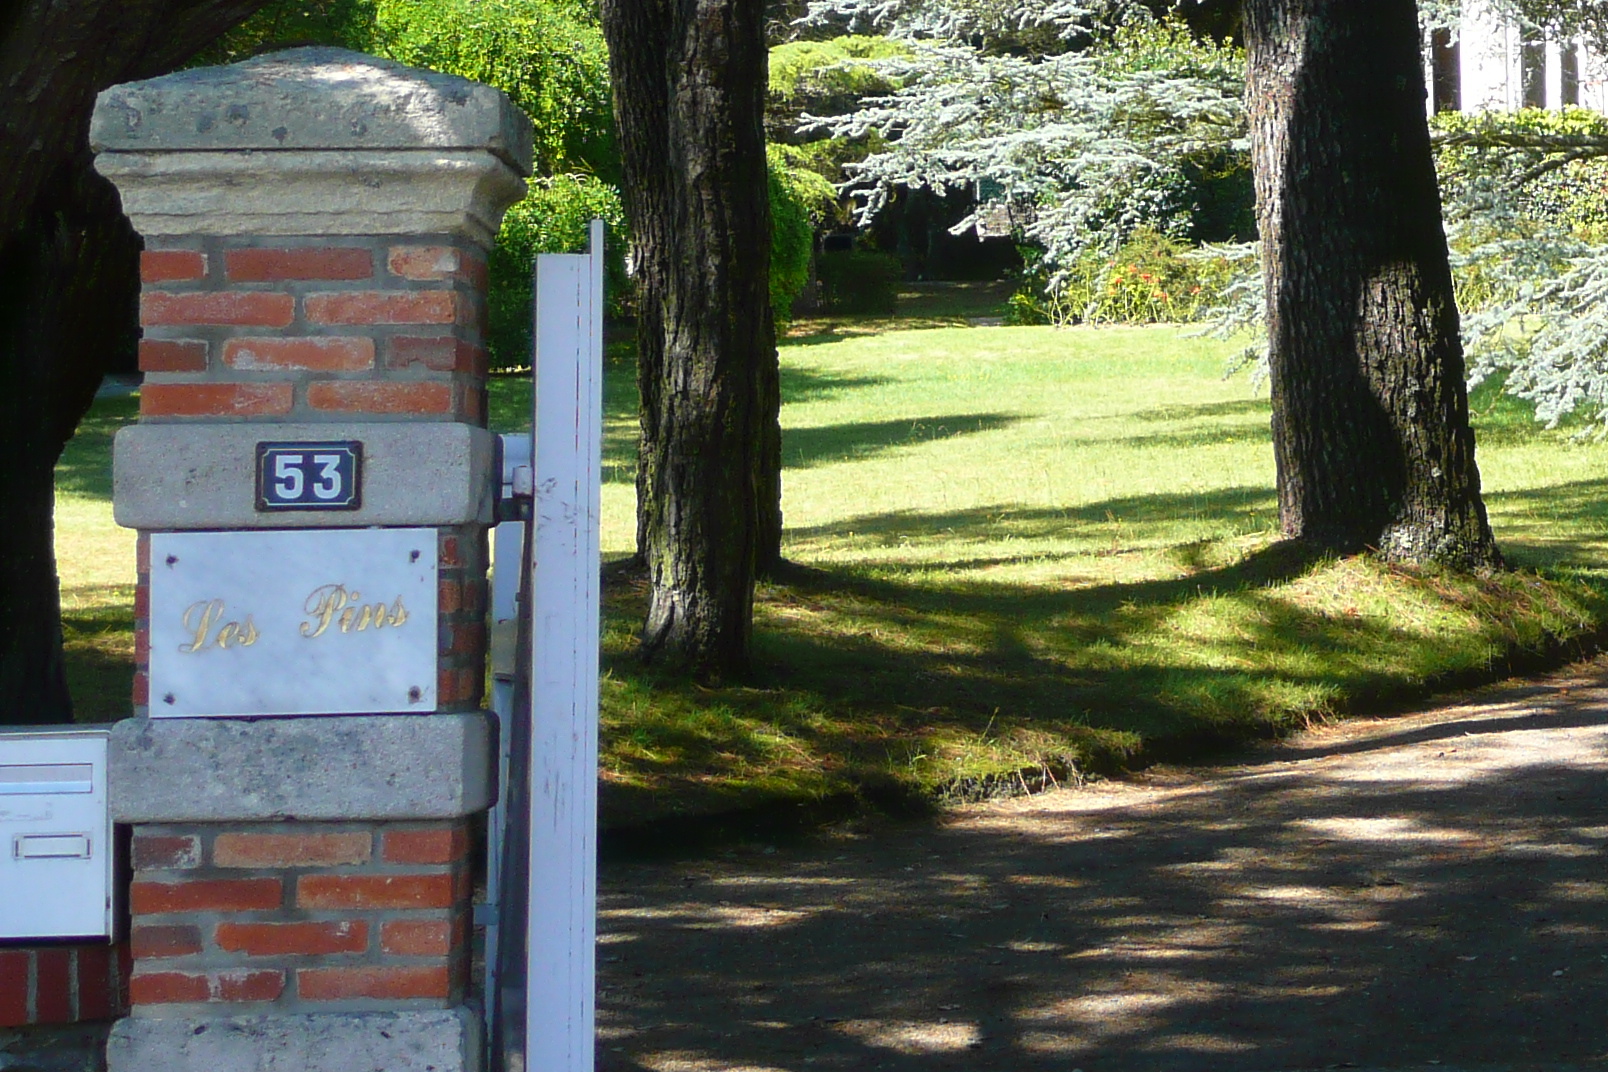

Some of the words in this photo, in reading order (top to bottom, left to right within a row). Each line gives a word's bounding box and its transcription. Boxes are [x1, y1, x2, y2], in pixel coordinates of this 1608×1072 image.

[274, 454, 342, 499] 53
[178, 598, 259, 653] Les
[299, 583, 409, 638] Pins
